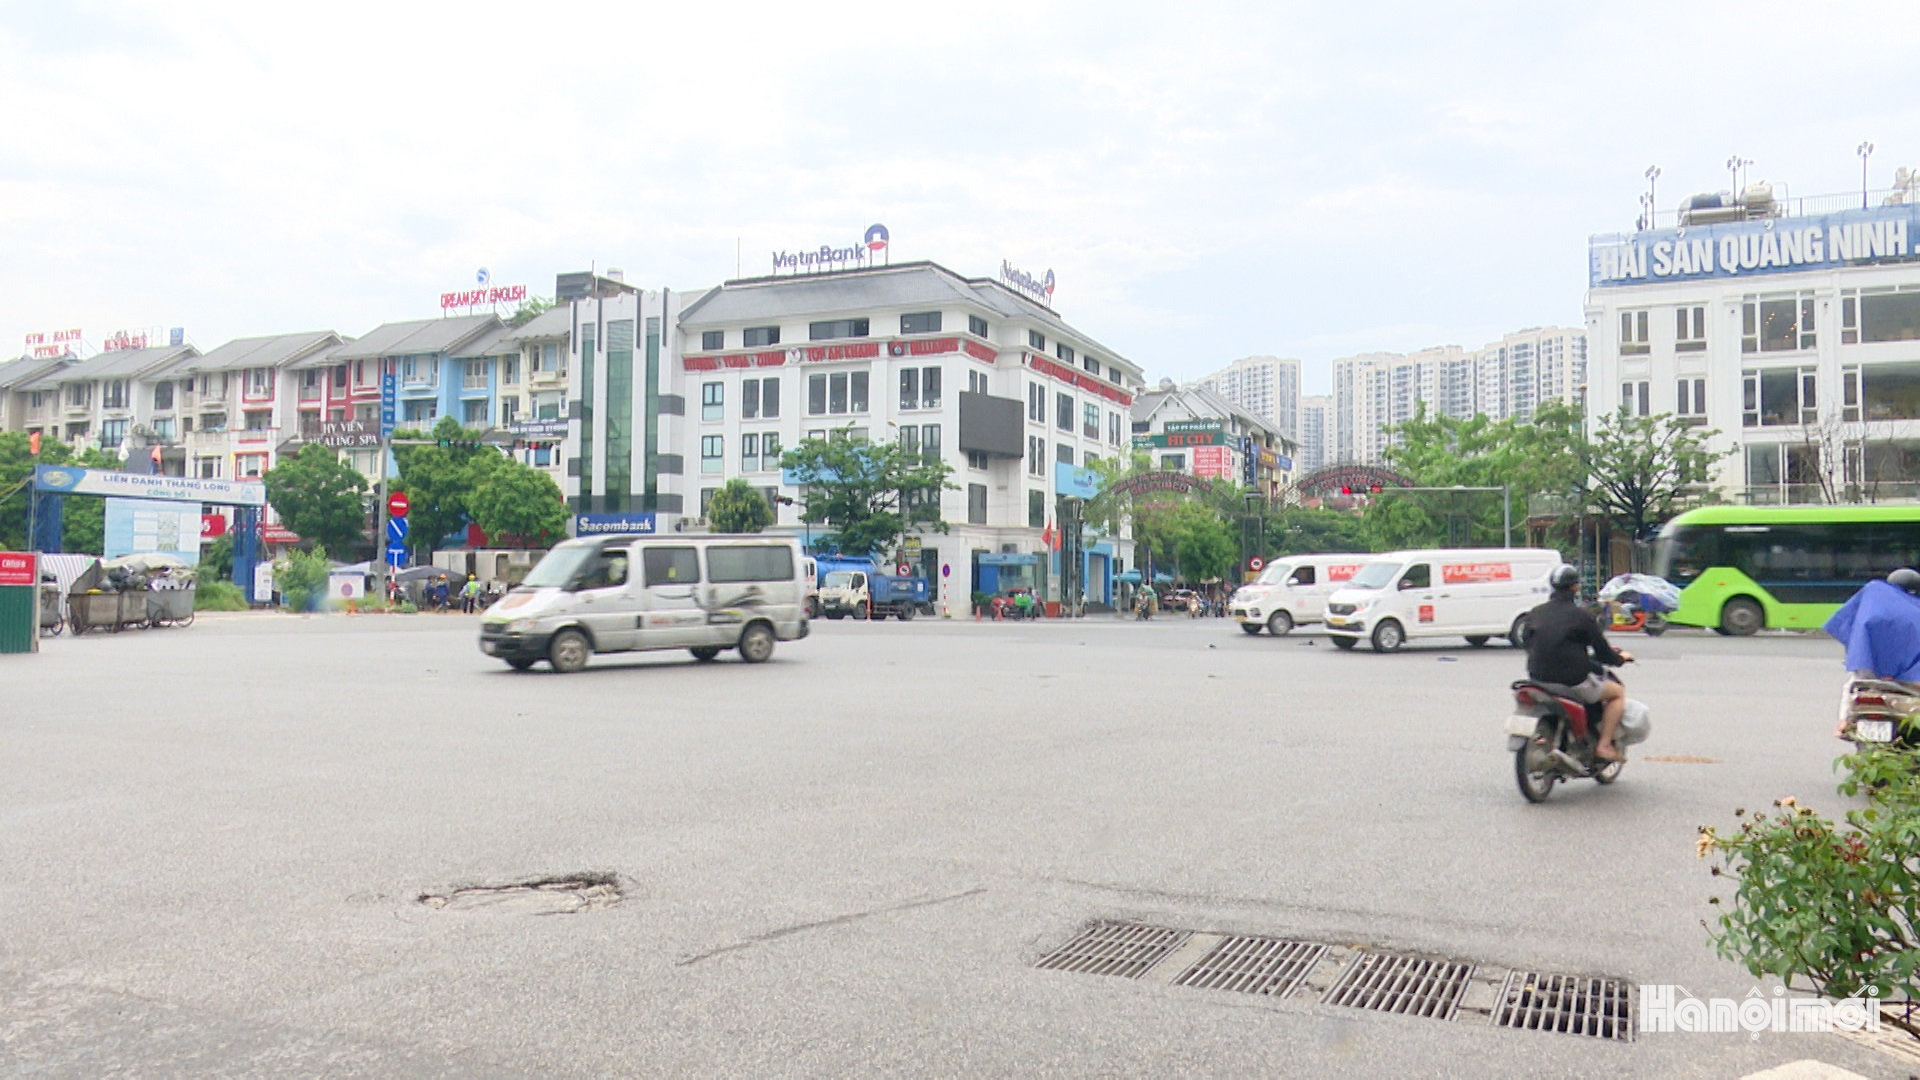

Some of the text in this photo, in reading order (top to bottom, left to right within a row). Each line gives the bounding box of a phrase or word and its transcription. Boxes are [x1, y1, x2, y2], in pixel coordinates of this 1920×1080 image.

[772, 242, 865, 268] VietinBank
[1652, 230, 1713, 277] SẢN
[1719, 219, 1824, 275] QUẢNG
[1828, 219, 1908, 261] NINH
[441, 292, 469, 308] DREAM
[358, 435, 378, 446] SPA
[1167, 433, 1184, 446] FIT
[1186, 432, 1214, 446] CITY
[131, 477, 163, 486] DANH
[579, 517, 651, 532] Sacombank
